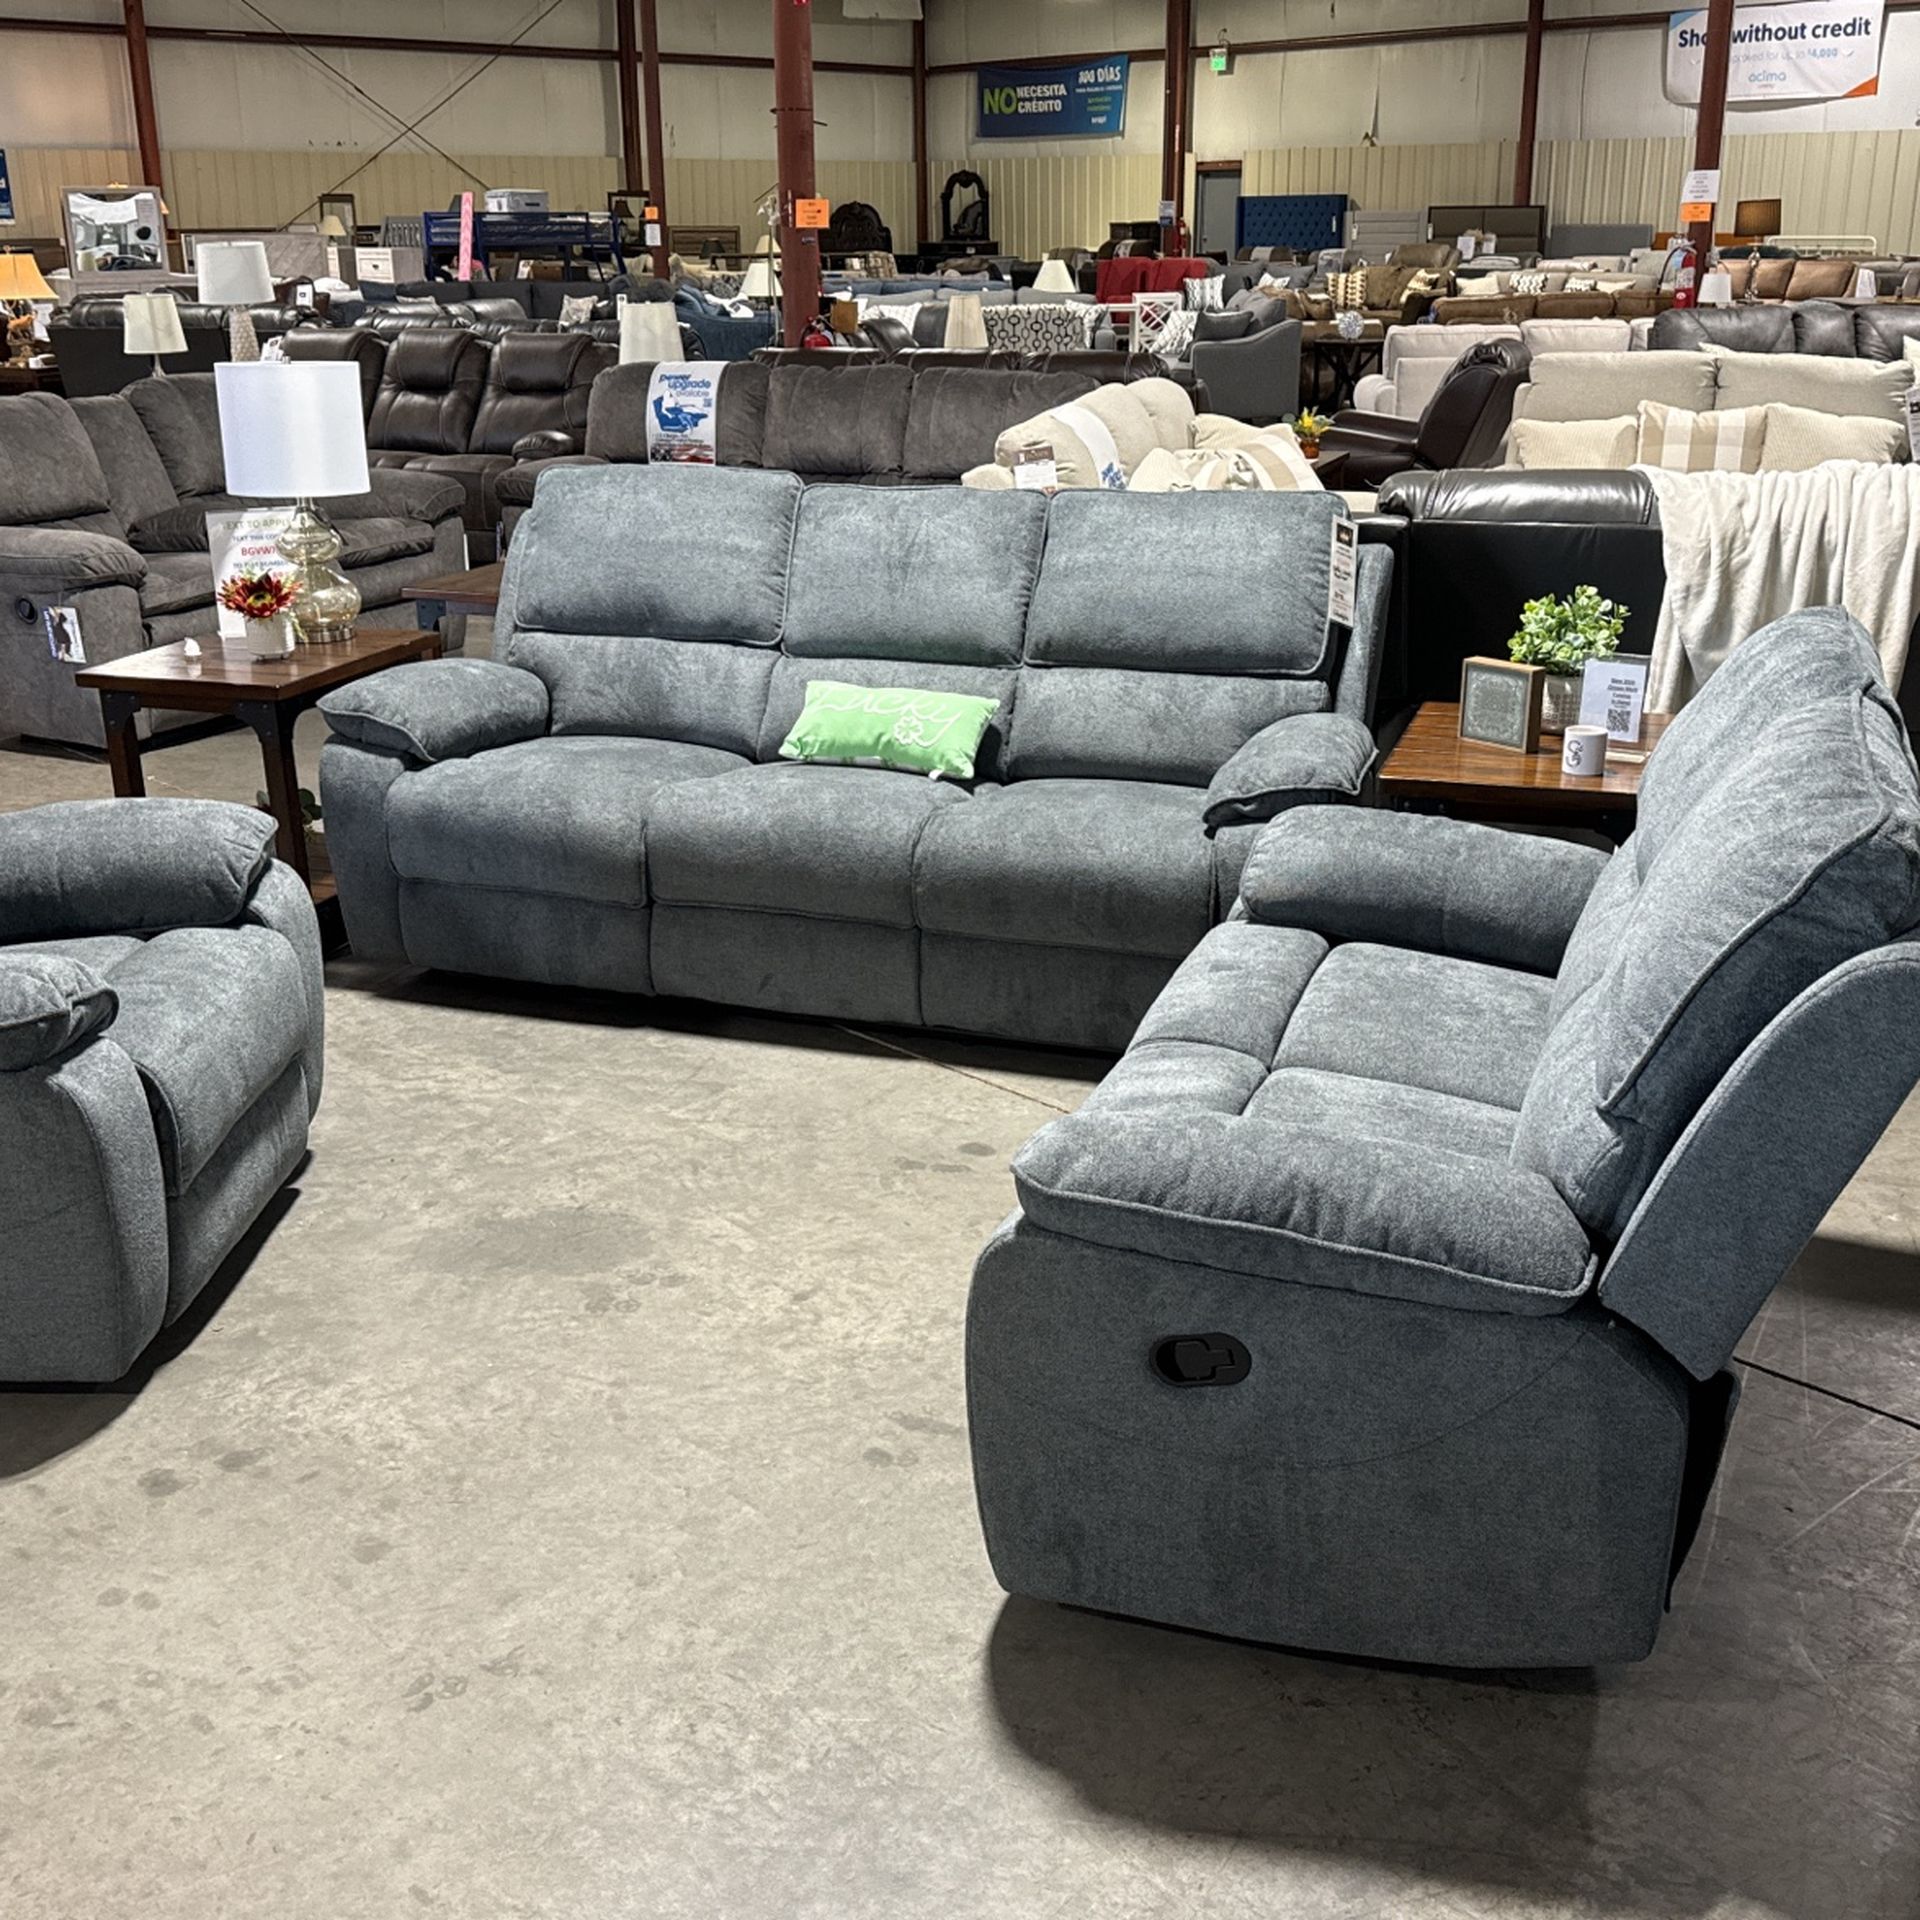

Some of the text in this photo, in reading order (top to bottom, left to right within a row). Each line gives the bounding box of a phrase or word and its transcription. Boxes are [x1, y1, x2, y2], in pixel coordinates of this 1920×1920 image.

[1732, 22, 1807, 44] without
[1811, 17, 1872, 40] credit
[1097, 65, 1121, 83] DÍAS
[1748, 69, 1787, 83] acima
[983, 87, 1018, 115] NO
[1017, 83, 1068, 99] NECESITA
[1017, 98, 1062, 114] CRÉDITO
